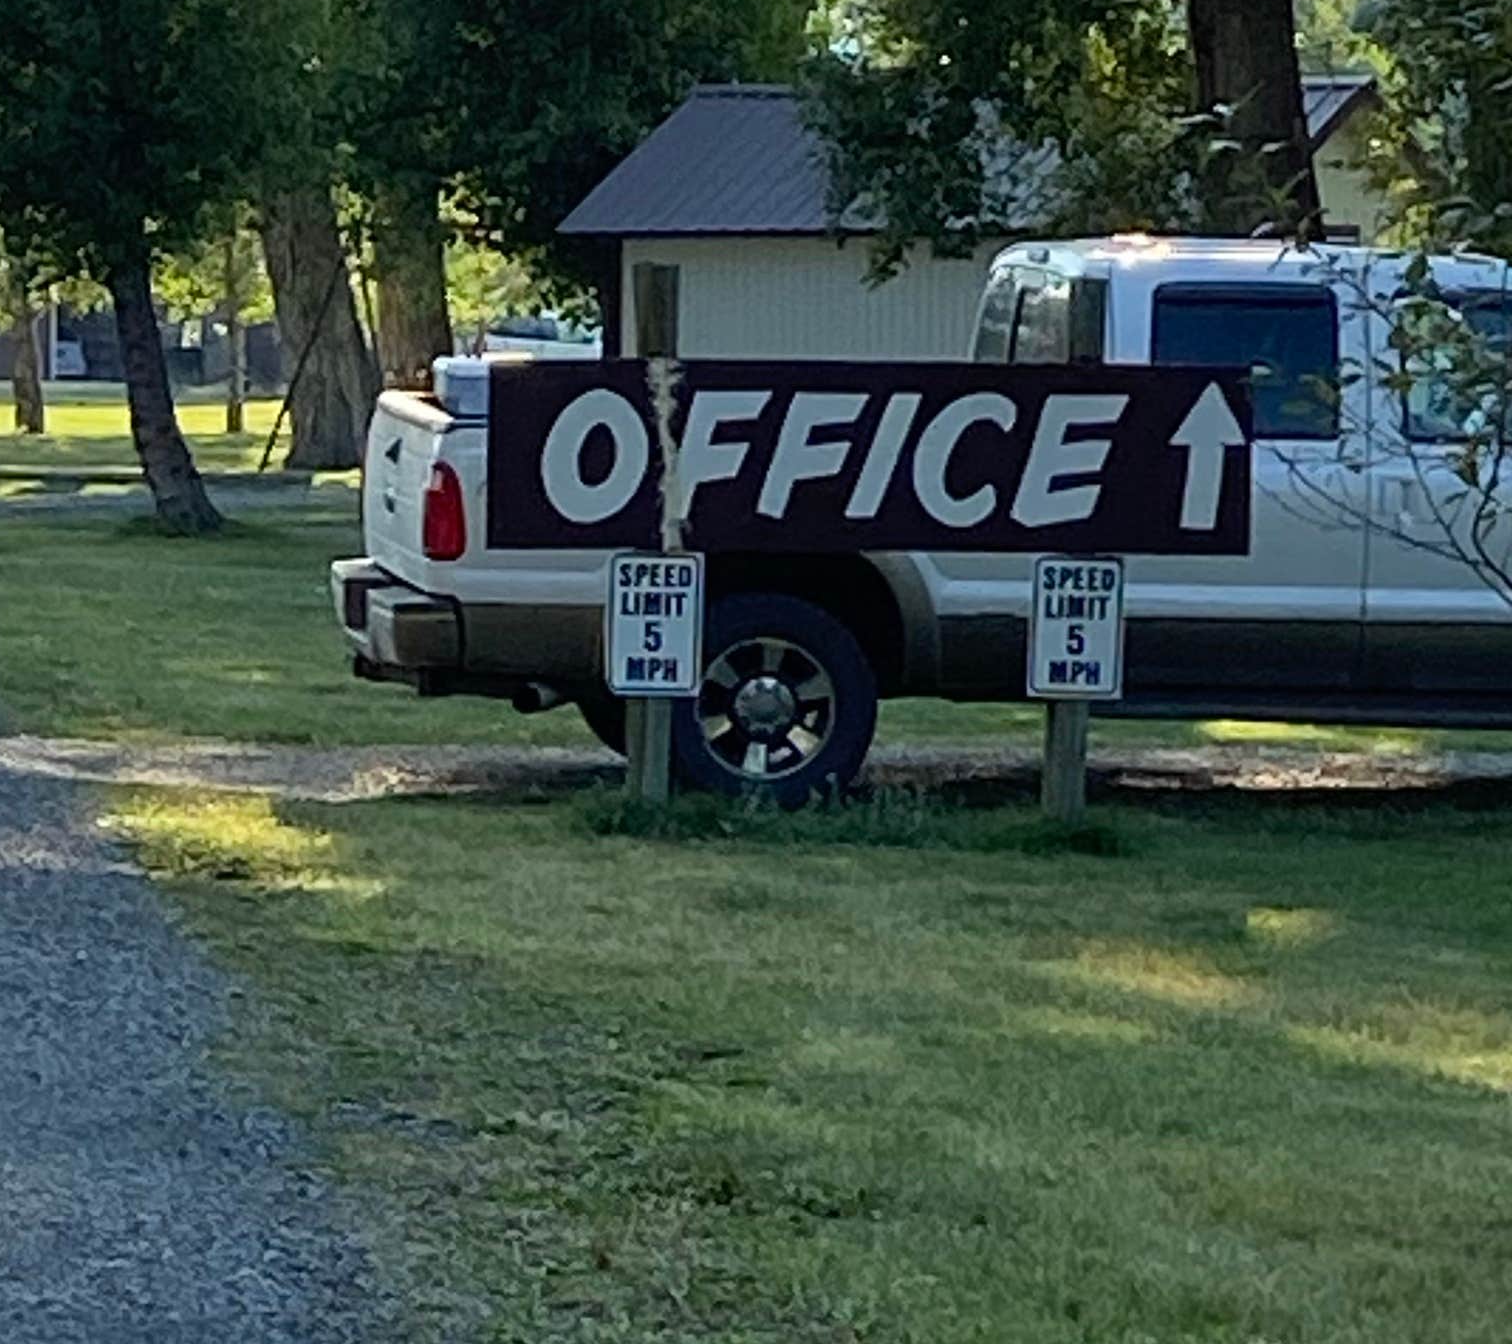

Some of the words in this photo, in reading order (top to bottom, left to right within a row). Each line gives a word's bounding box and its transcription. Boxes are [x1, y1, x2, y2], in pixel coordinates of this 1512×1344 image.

[541, 388, 1130, 528] OFFICE
[619, 563, 692, 587] SPEED
[1043, 566, 1116, 591] SPEED
[620, 591, 688, 617] LIMIT
[1045, 594, 1111, 620] LIMIT
[643, 620, 663, 652] 5
[1066, 623, 1085, 655] 5
[626, 657, 678, 682] MPH
[1048, 660, 1102, 685] MPH
